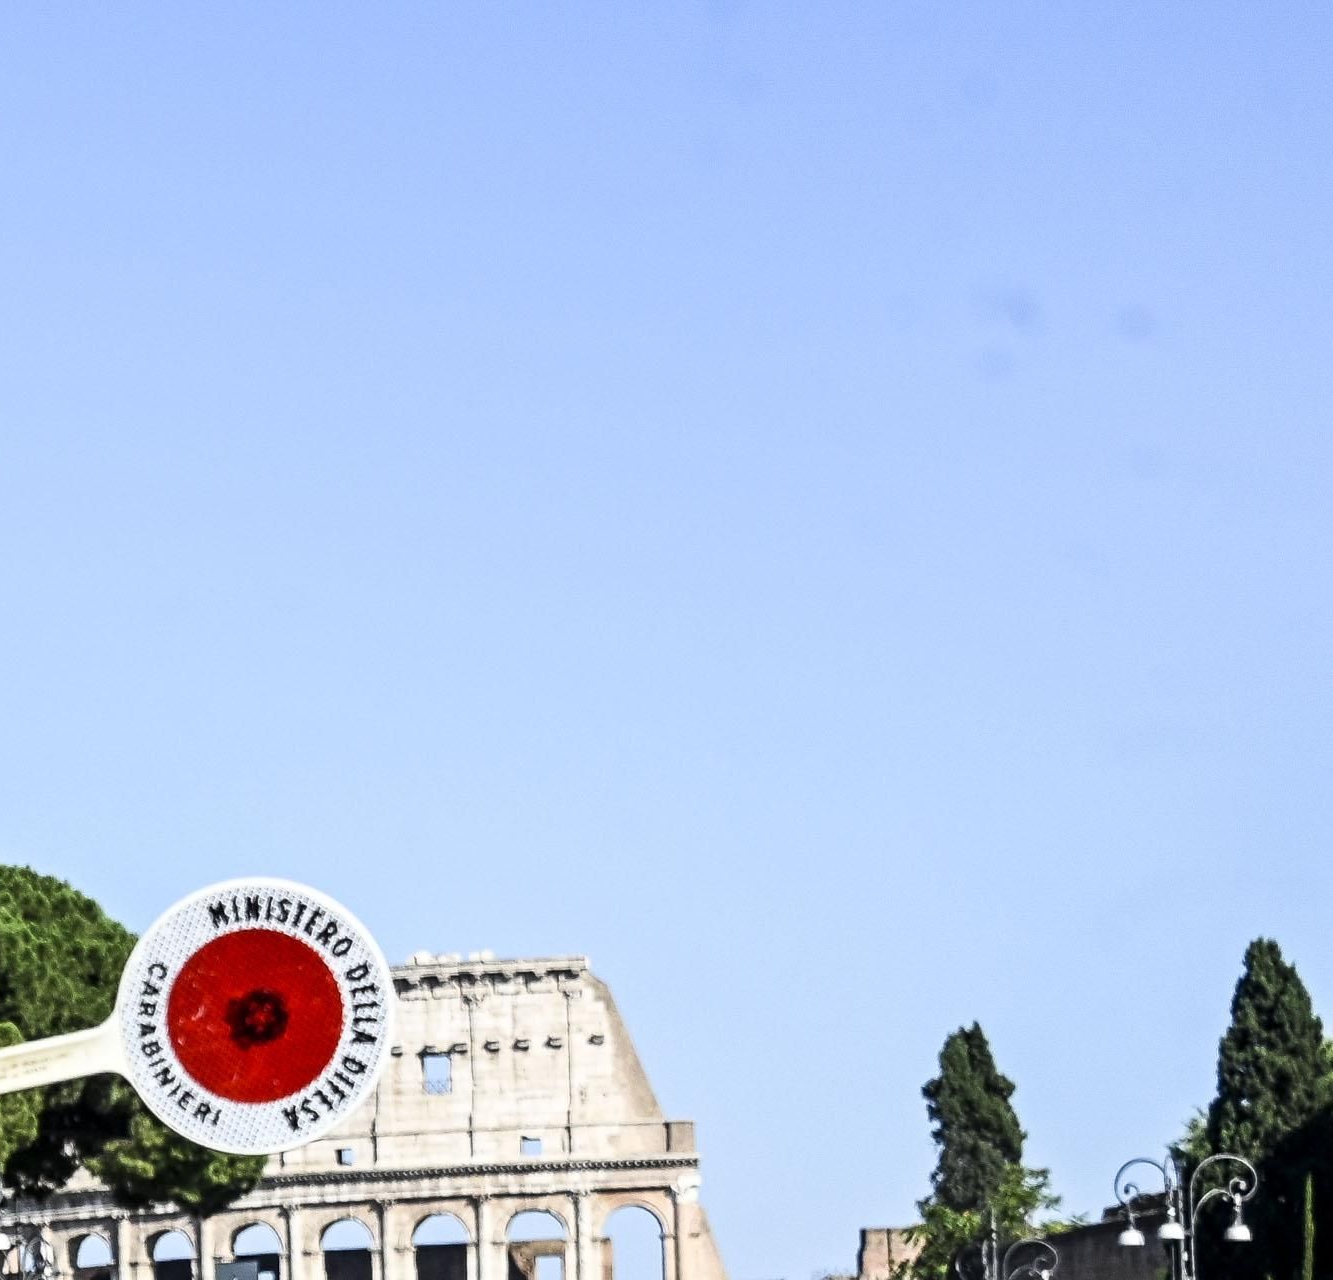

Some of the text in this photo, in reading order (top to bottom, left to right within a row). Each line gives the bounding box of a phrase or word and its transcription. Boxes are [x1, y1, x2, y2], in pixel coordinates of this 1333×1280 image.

[138, 962, 223, 1127] CARABINIERI
[208, 894, 381, 1132] MINISTERO DELLA DIFESA
